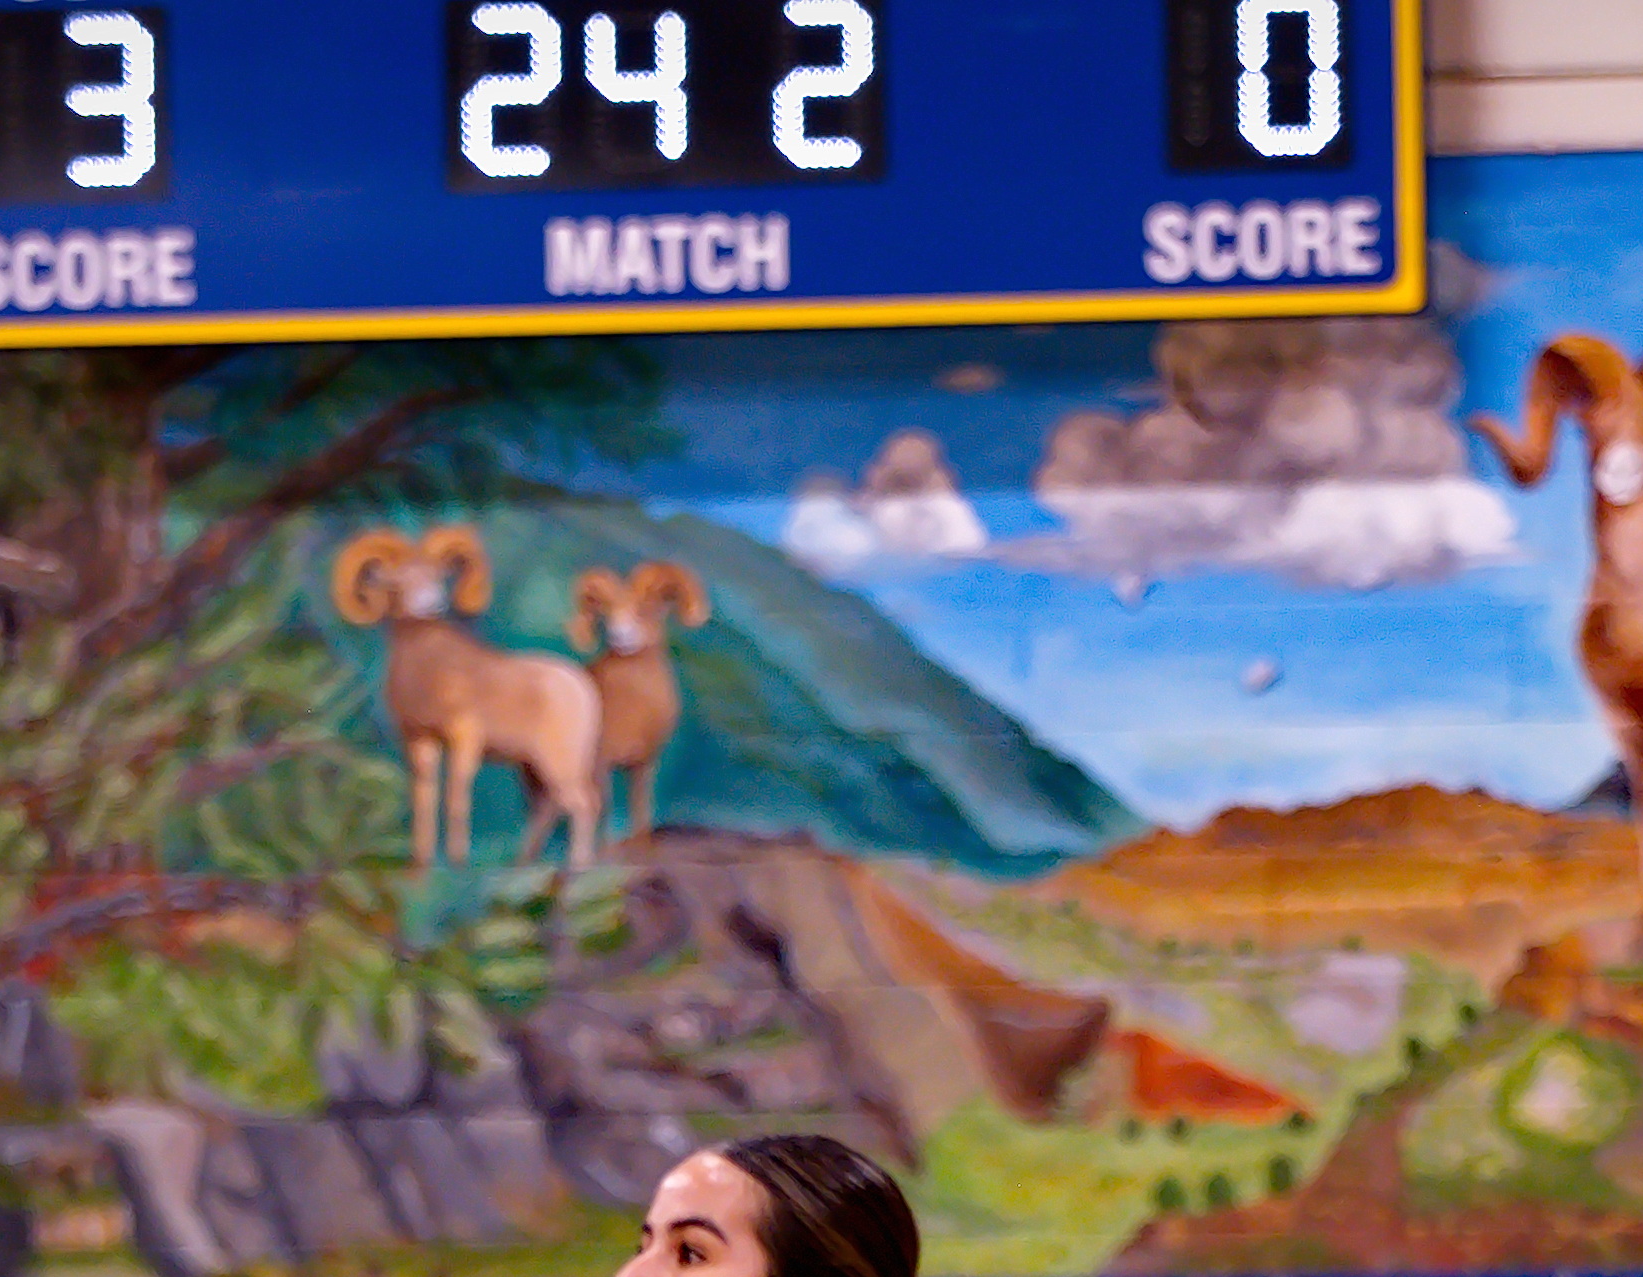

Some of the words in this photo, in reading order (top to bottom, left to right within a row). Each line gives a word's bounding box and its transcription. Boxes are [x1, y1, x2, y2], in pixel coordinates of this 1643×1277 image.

[64, 11, 156, 187] 3
[461, 3, 688, 177] 24
[772, 0, 874, 169] 2
[1236, 0, 1341, 157] 0
[545, 213, 789, 295] MATCH
[1144, 197, 1382, 283] SCORE
